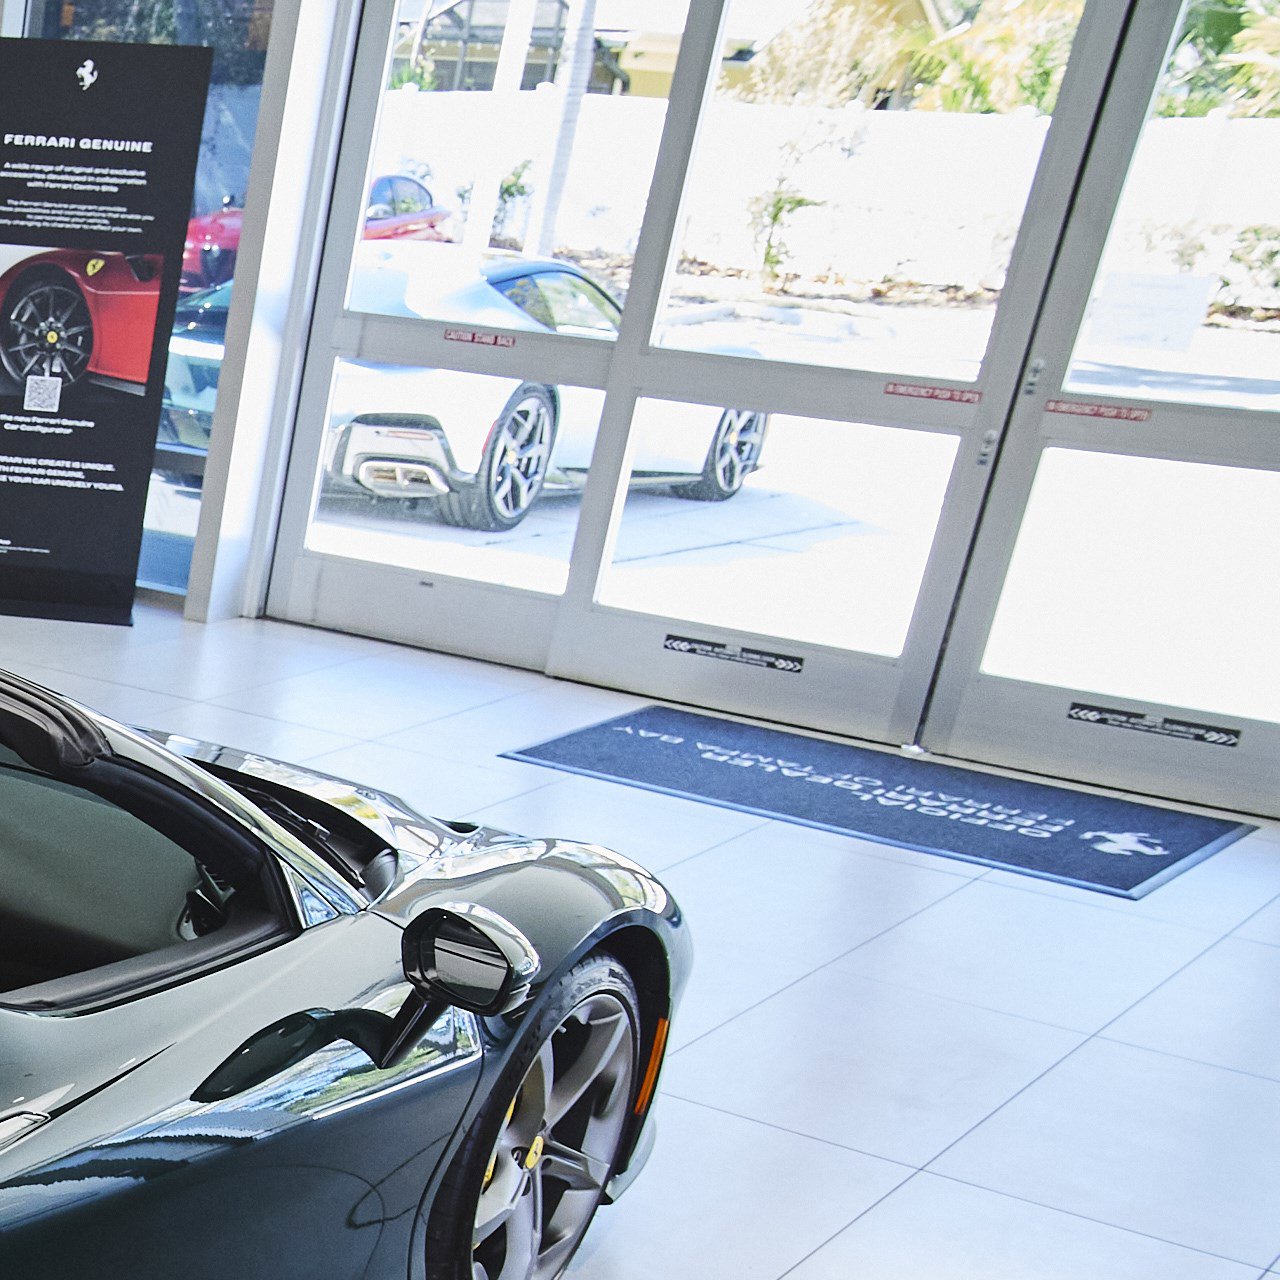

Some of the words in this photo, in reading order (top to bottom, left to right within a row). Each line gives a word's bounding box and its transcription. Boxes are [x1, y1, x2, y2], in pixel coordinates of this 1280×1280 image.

[3, 133, 75, 148] FERRARI
[79, 136, 153, 153] GENUINE
[55, 164, 64, 172] of
[45, 182, 72, 190] Ferrari
[4, 422, 19, 431] Car
[31, 416, 61, 424] Ferrari
[22, 457, 38, 465] WE
[38, 458, 71, 468] CREATE
[10, 466, 46, 475] FERRARI
[7, 475, 32, 484] YOUR
[32, 477, 51, 485] CAR
[612, 726, 684, 745] BAY
[696, 741, 814, 773] TAMPA
[701, 751, 863, 790] DEALER
[832, 772, 883, 787] OF
[872, 788, 1064, 832] FERRARI
[895, 784, 1075, 827] FERRARI
[851, 789, 1052, 838] OFFICIAL
